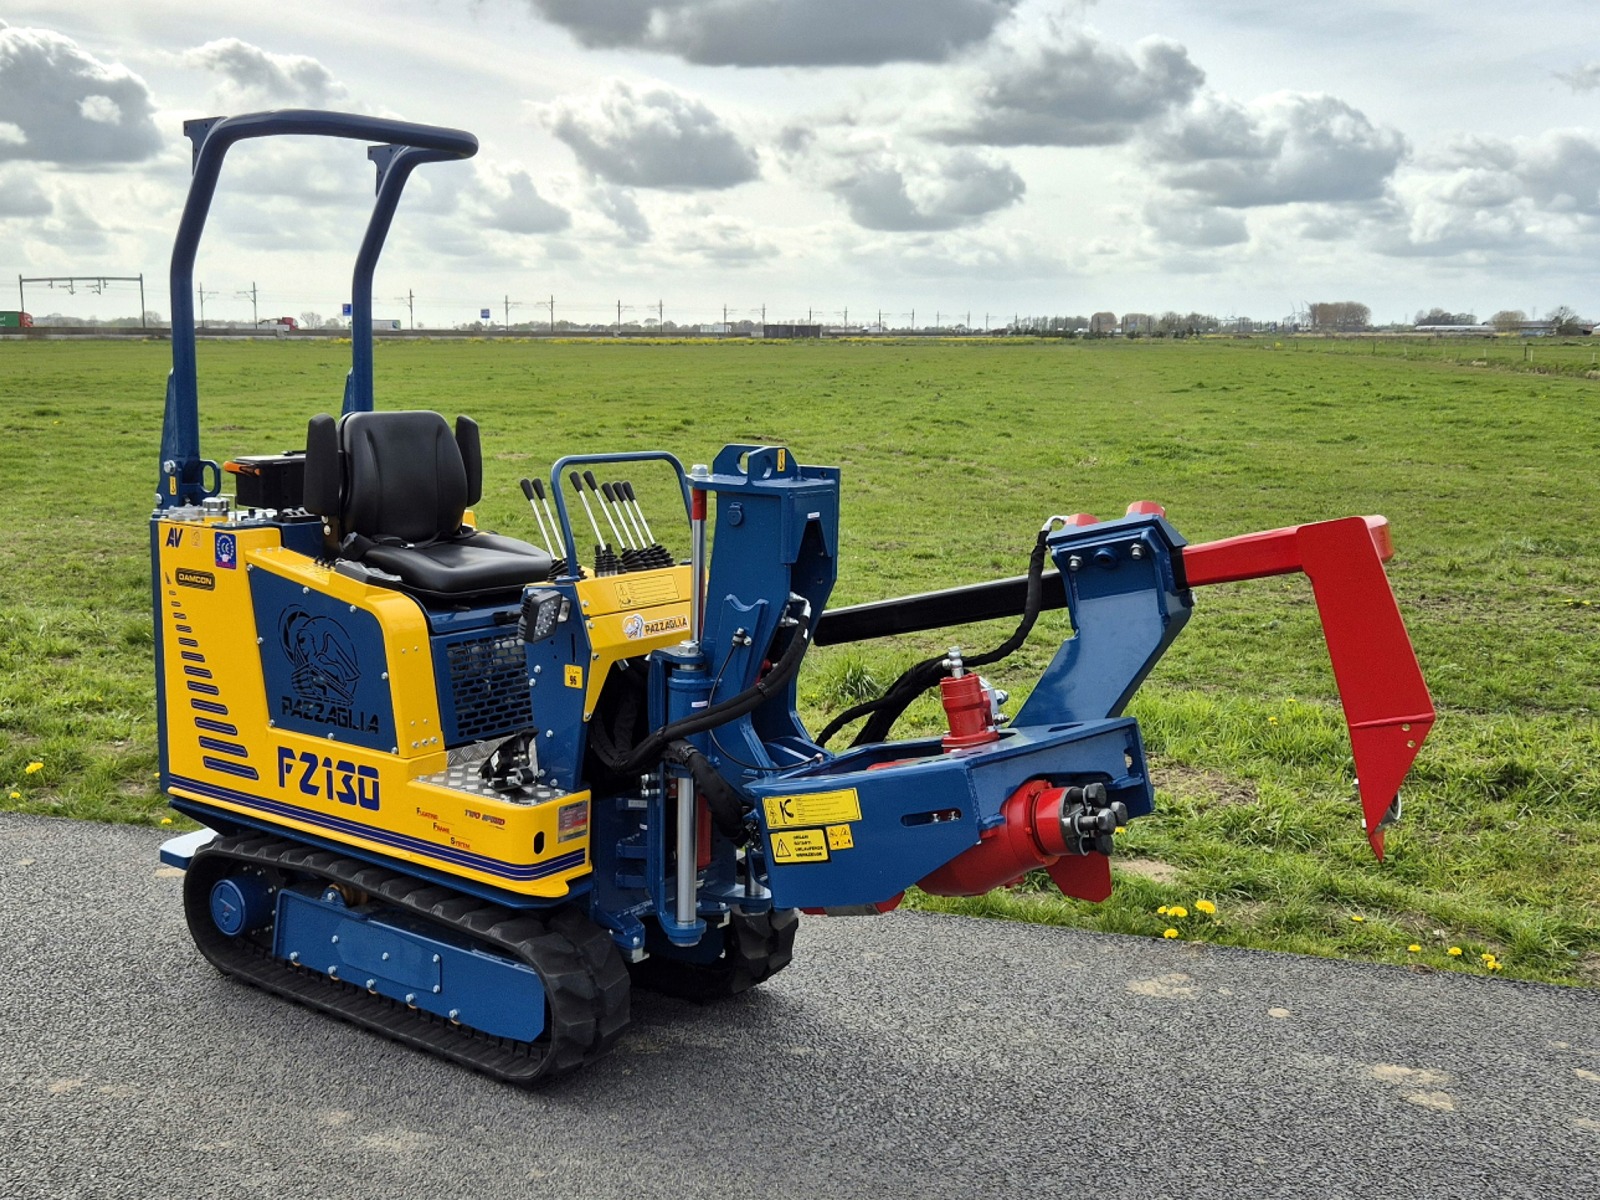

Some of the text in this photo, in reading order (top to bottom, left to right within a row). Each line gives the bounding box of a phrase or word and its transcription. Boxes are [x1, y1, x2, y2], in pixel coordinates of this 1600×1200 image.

[166, 527, 183, 548] AV
[178, 573, 212, 585] DAMCON
[644, 617, 688, 634] PAZZAGLIA
[281, 695, 379, 734] PAZZAGLIA
[277, 745, 380, 812] PZ130
